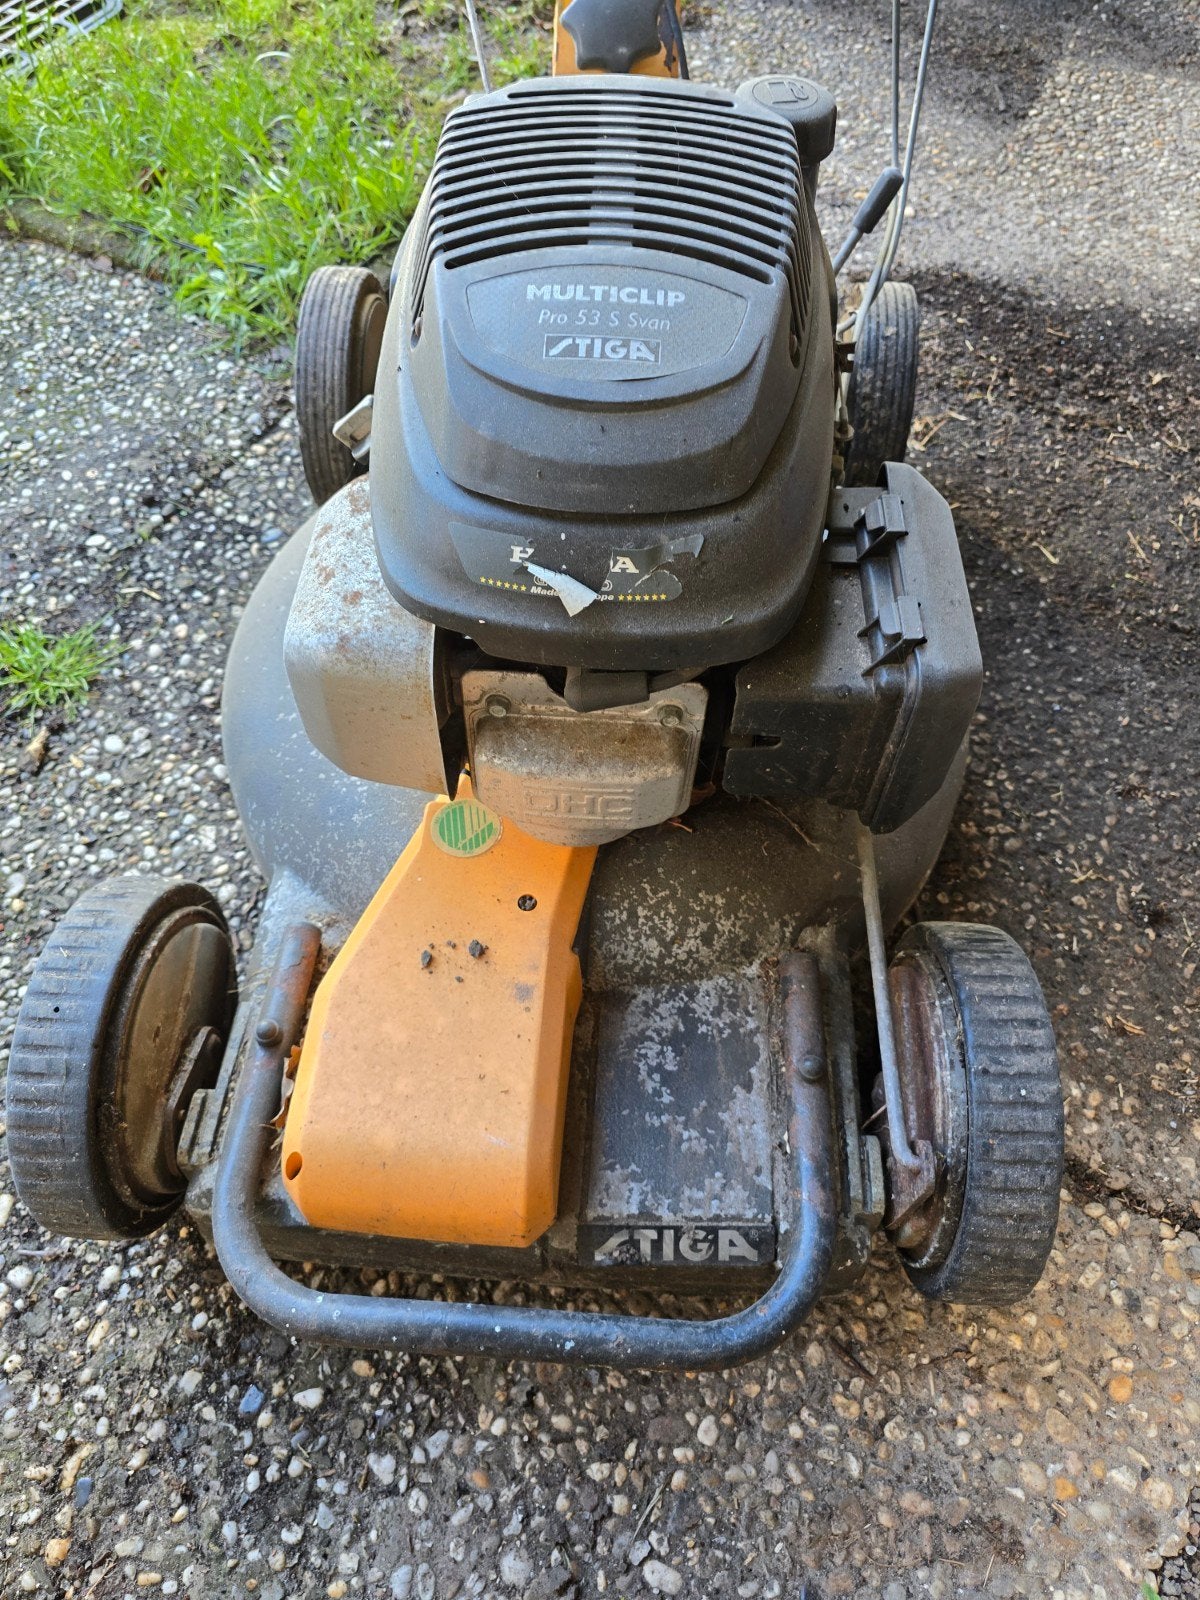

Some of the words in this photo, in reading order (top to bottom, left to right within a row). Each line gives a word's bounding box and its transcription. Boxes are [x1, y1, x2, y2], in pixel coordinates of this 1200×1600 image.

[526, 284, 686, 307] MULTICLIP
[538, 309, 568, 324] Pro
[575, 309, 600, 325] 53
[609, 311, 620, 327] S
[627, 312, 670, 331] Svan
[549, 337, 656, 361] STIGA
[524, 793, 633, 814] OHC
[594, 1229, 758, 1262] STIGA
